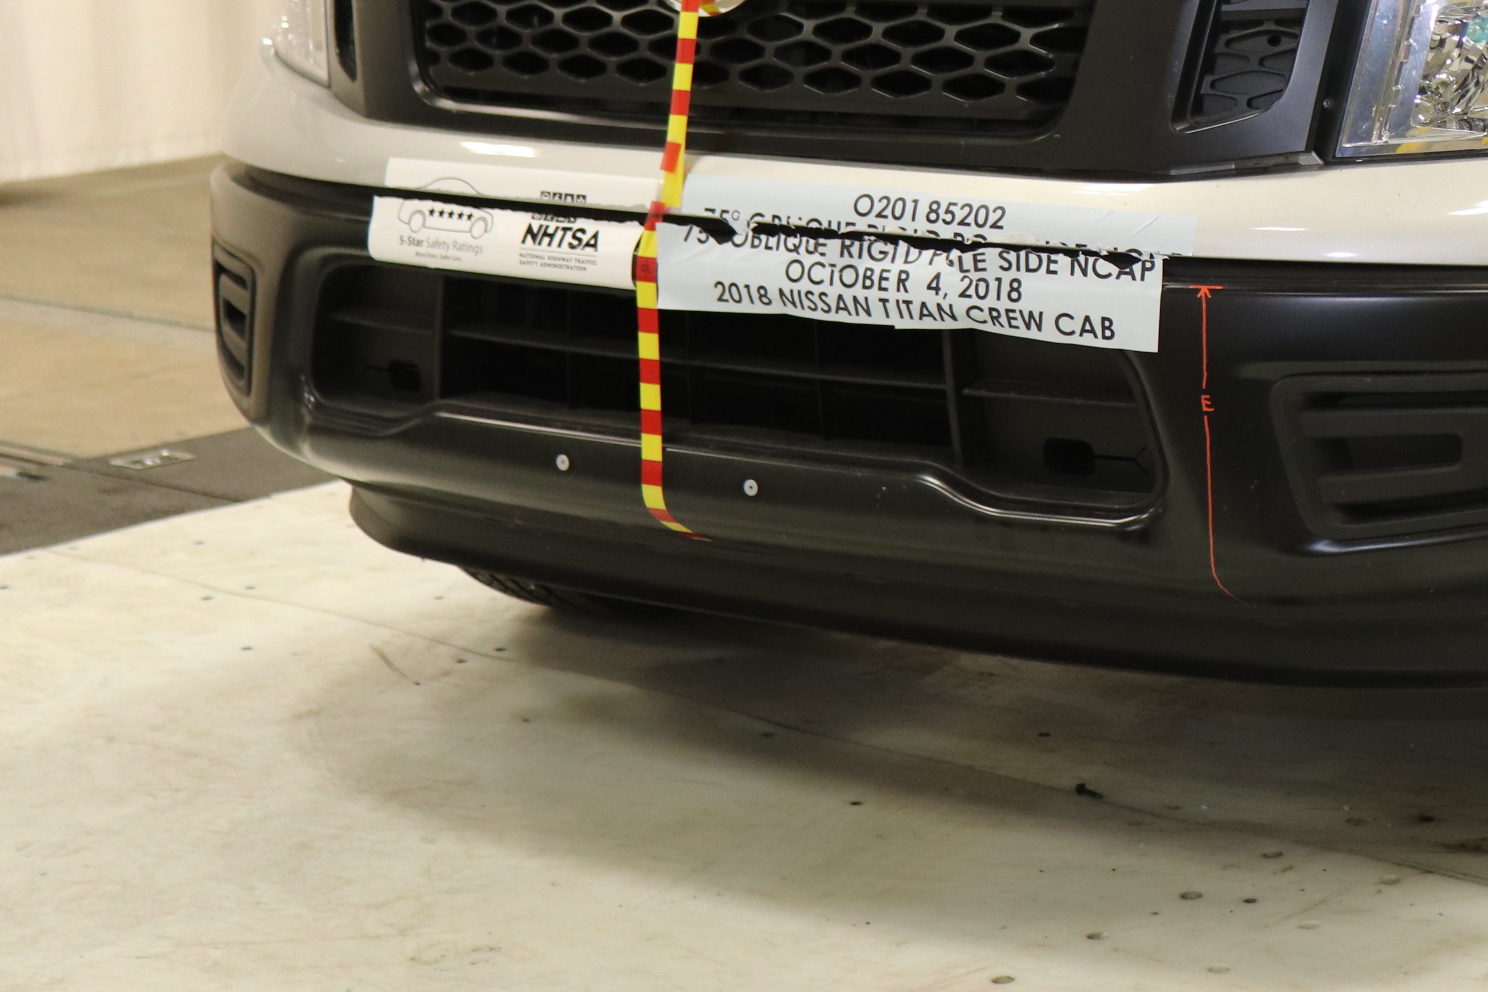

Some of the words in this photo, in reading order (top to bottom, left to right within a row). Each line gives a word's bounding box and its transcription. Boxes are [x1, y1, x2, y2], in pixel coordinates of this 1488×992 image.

[425, 237, 450, 252] Safety
[452, 240, 484, 255] Ratings
[521, 222, 600, 252] NHTSA
[785, 259, 910, 293] OCTOBER
[926, 272, 948, 300] 4,
[958, 275, 1023, 303] 2018
[714, 281, 772, 306] 2018
[778, 288, 873, 319] NISSAN
[878, 297, 958, 323] TITAN
[966, 305, 1044, 332] CREW
[1054, 312, 1116, 340] CAB
[1201, 394, 1215, 411] E
